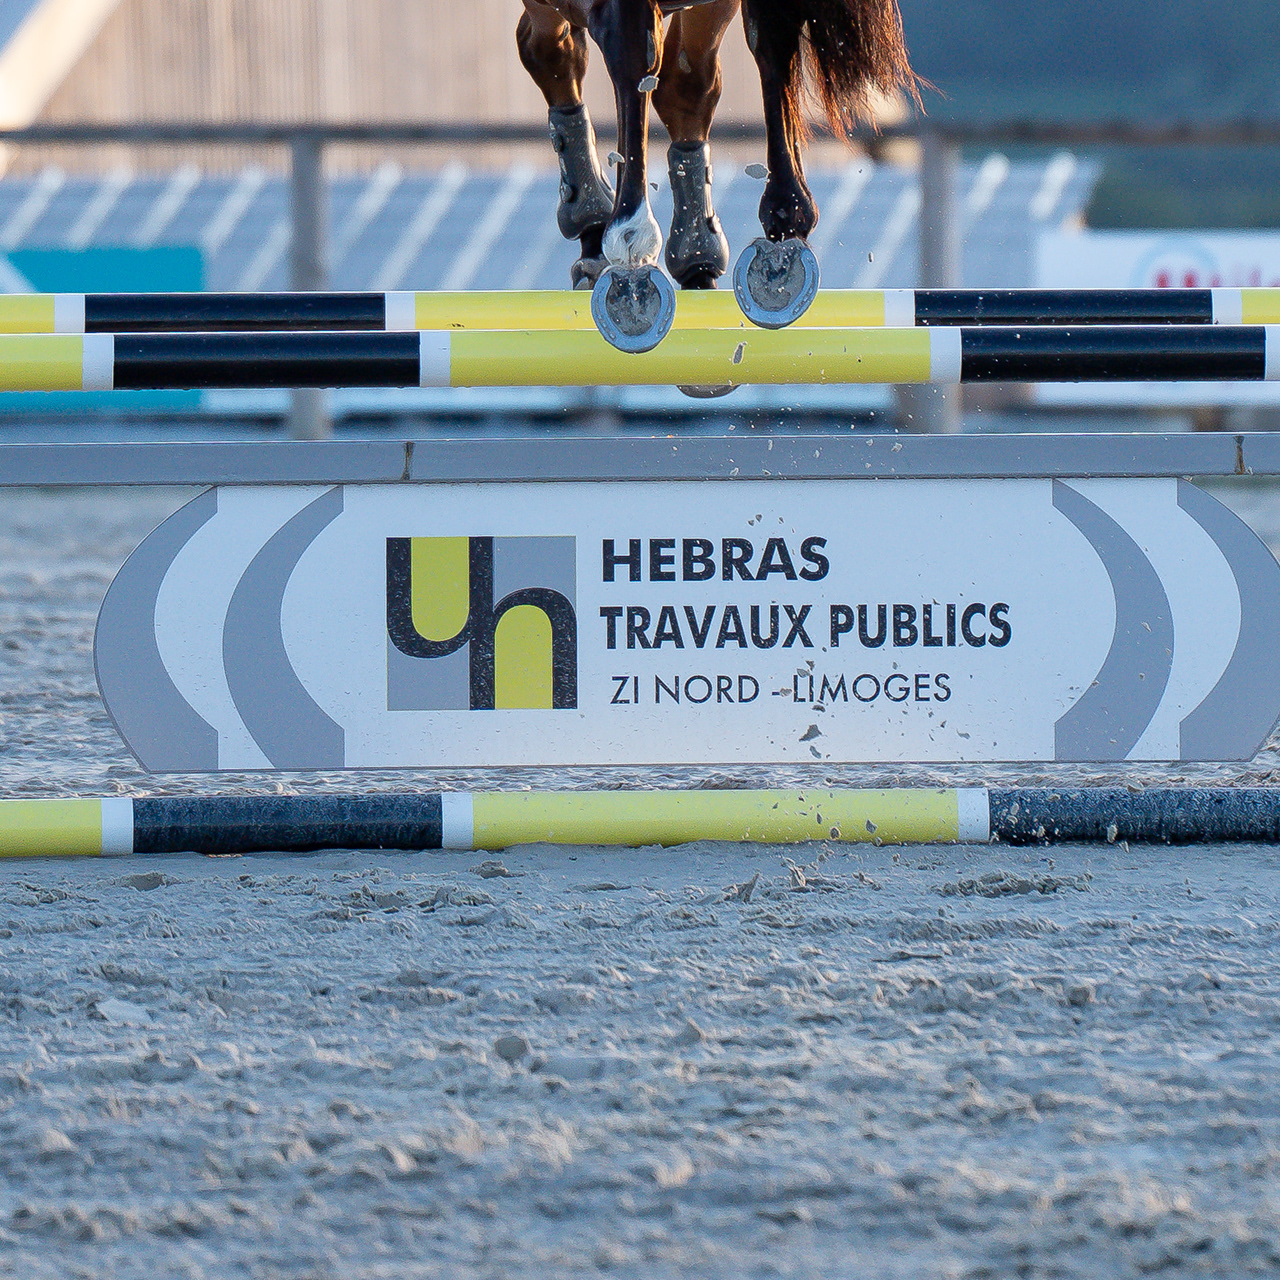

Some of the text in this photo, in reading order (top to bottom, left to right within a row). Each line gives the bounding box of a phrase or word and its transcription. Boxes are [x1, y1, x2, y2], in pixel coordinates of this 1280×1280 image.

[602, 537, 830, 582] HEBRAS
[600, 603, 1012, 649] TRAVAUX PUBLICS
[610, 675, 639, 705] ZI
[655, 674, 760, 705] NORD
[793, 673, 952, 703] LIMOGES
